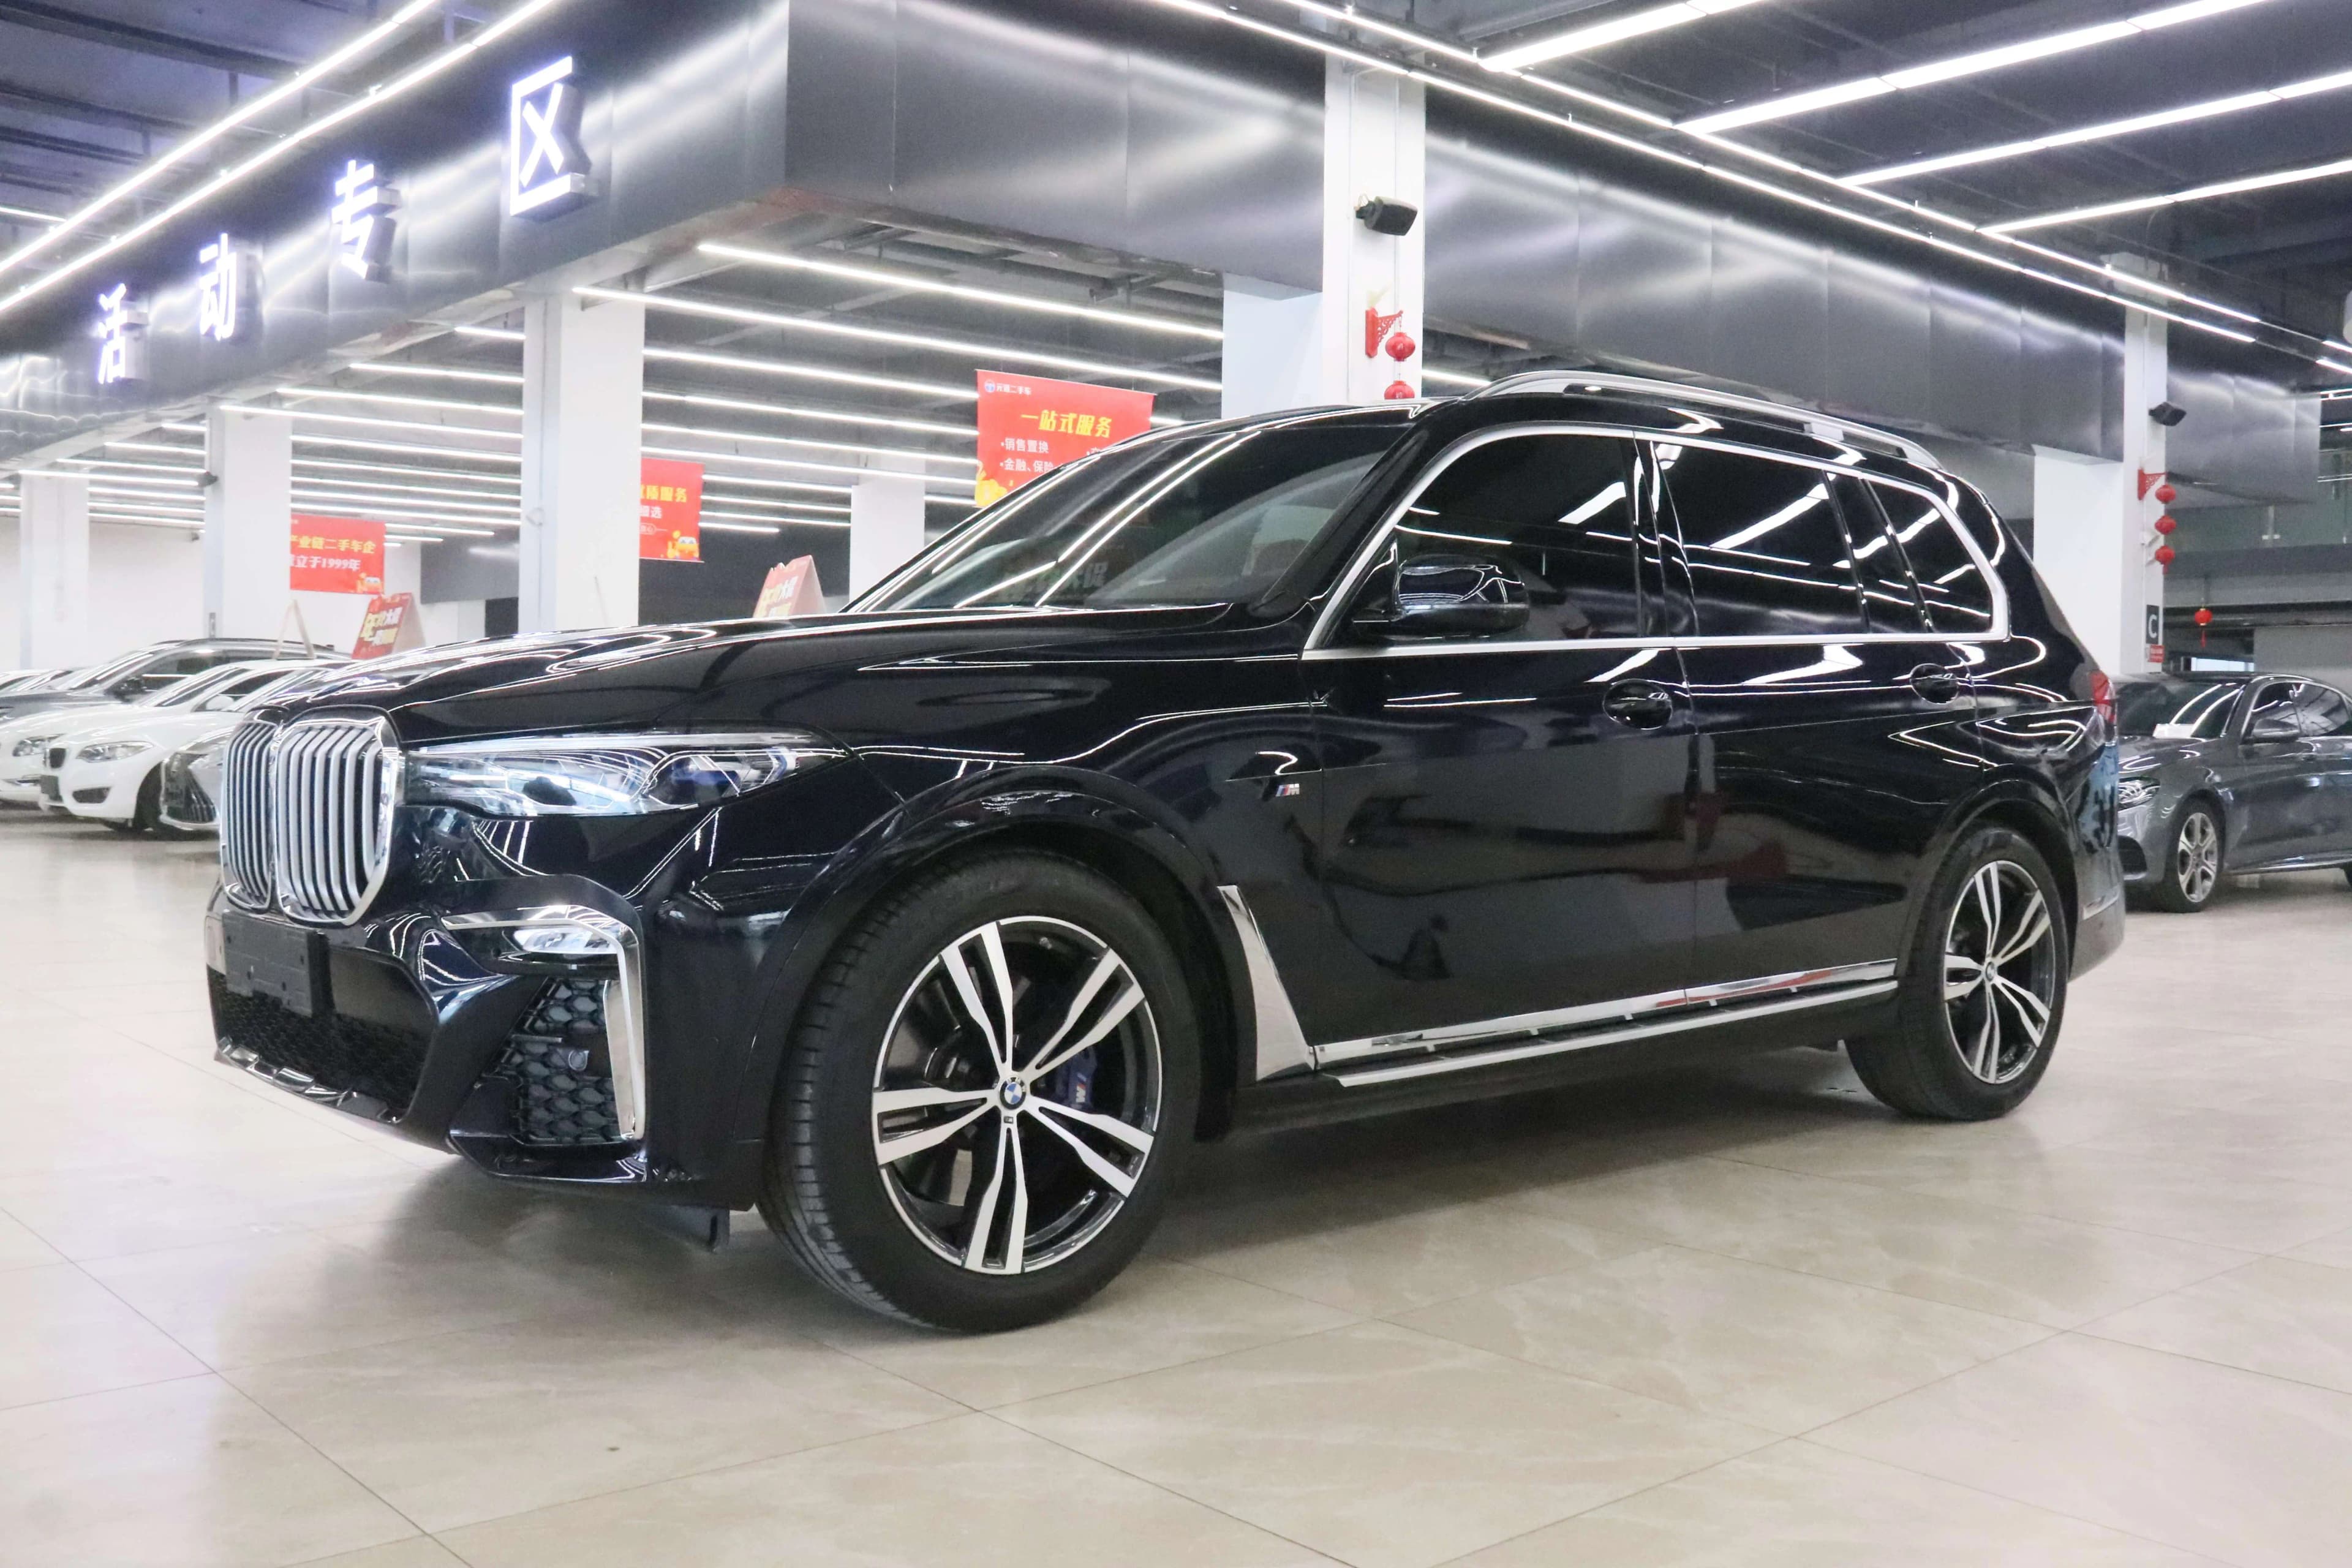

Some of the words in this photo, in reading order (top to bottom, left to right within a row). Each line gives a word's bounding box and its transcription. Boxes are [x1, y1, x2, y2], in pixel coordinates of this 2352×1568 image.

[1020, 409, 1112, 438] 一站式服务
[1005, 437, 1049, 454] 销售置换
[2148, 614, 2158, 638] C
